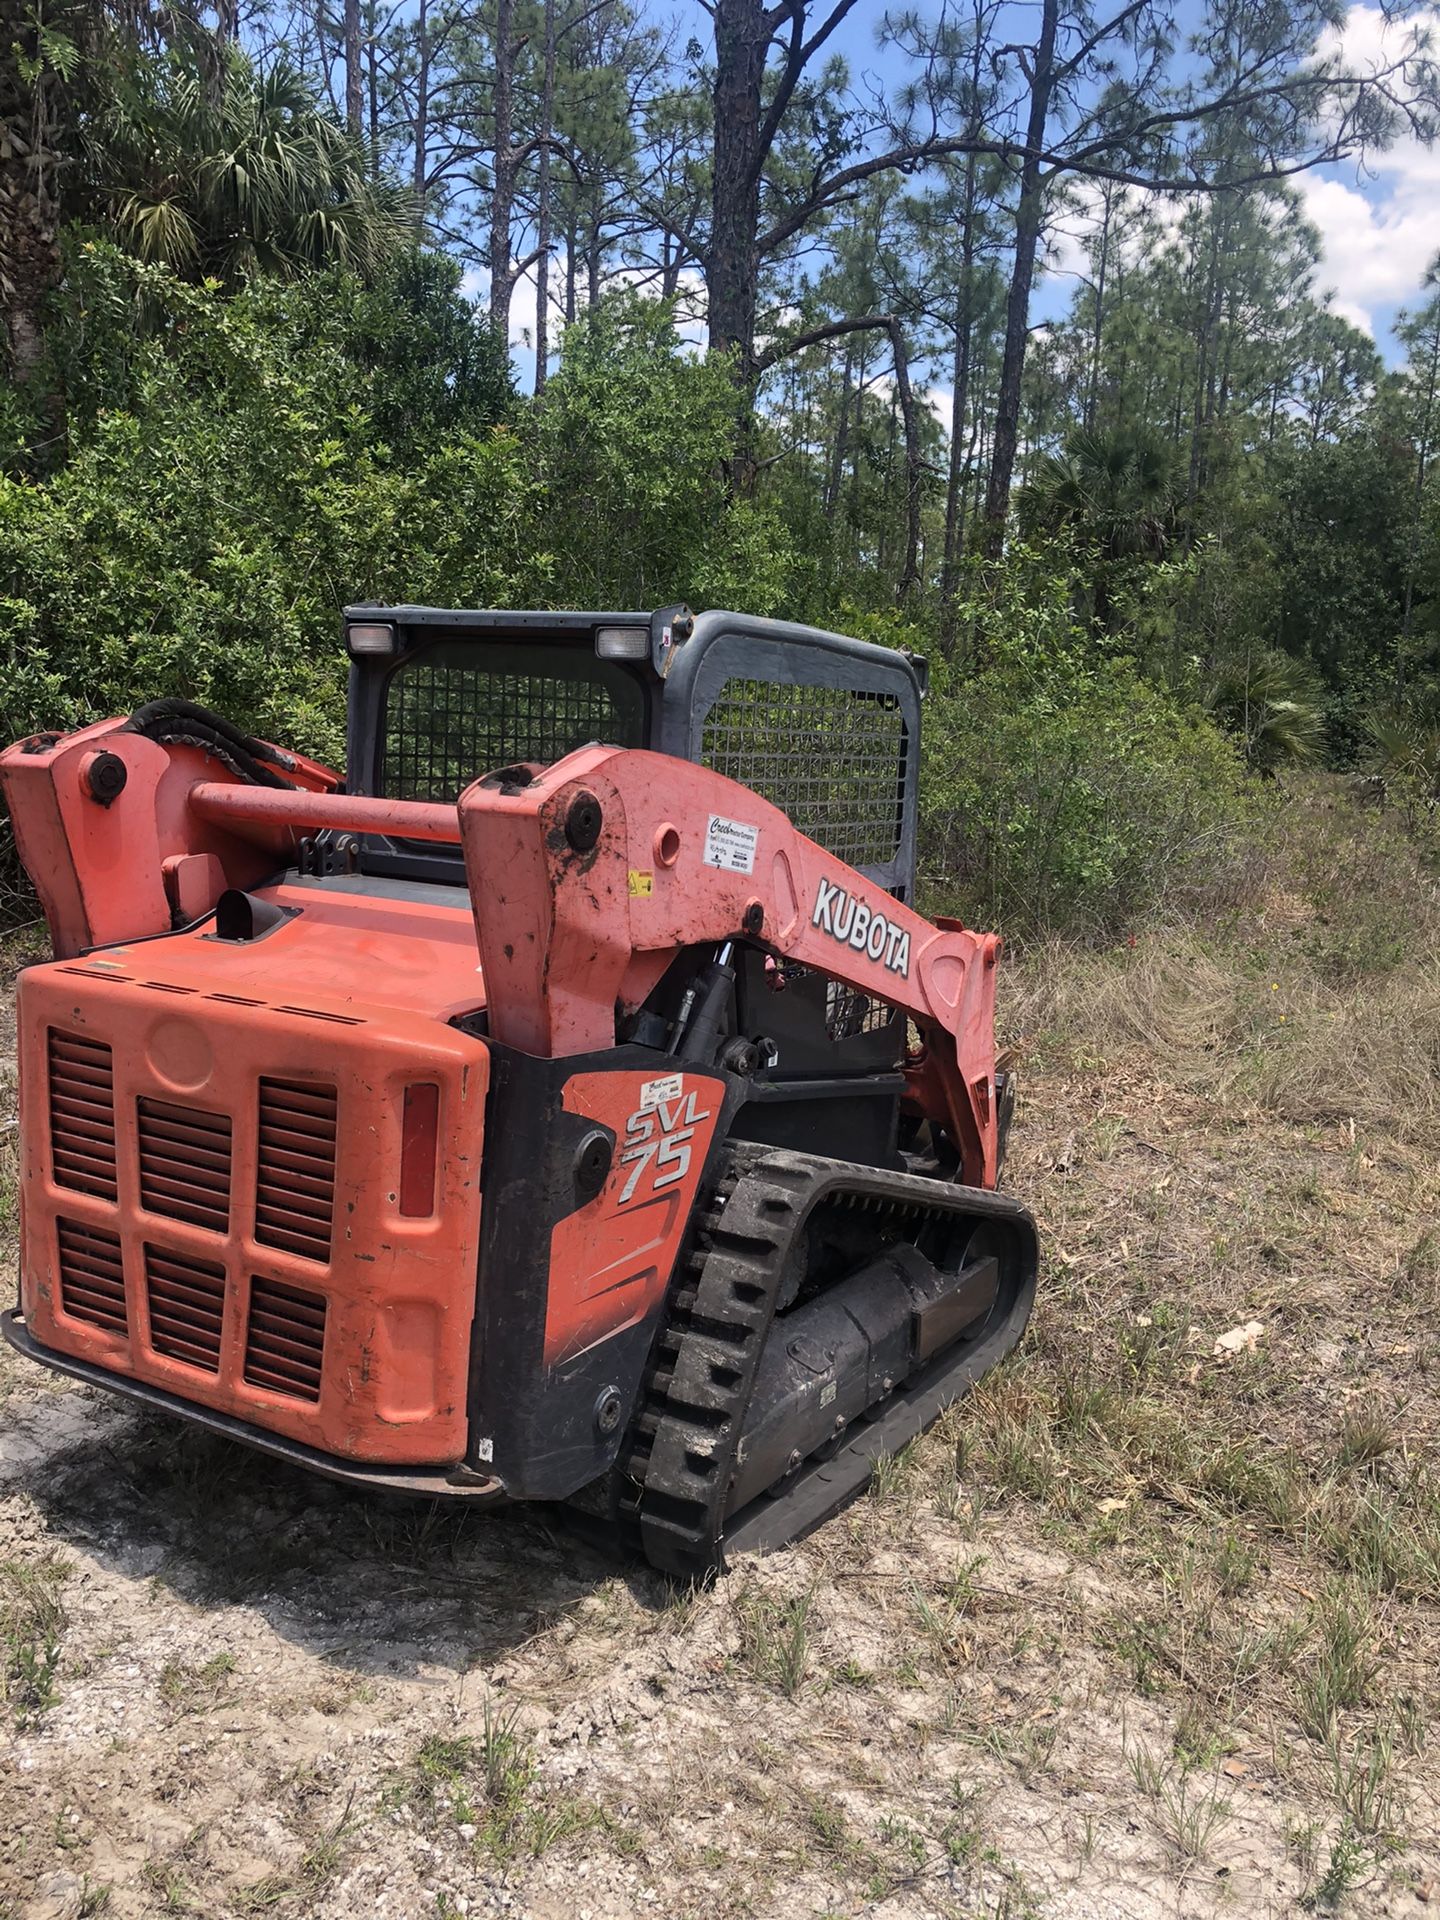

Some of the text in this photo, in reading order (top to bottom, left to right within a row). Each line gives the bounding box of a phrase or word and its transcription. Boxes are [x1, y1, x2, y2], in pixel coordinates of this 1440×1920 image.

[812, 876, 911, 980] KUBOTA
[623, 1089, 711, 1149] SVL
[617, 1127, 696, 1207] 75
